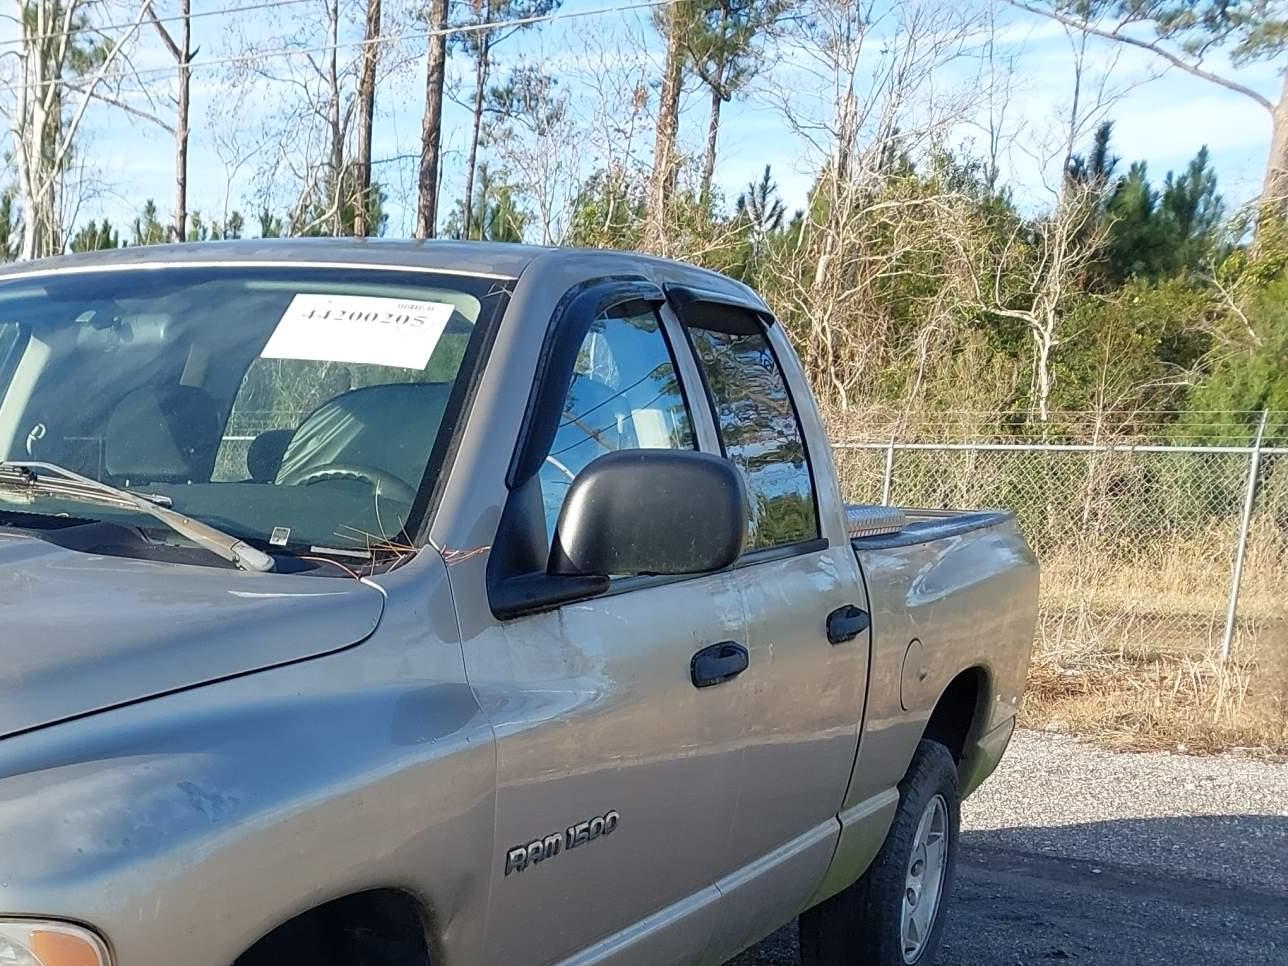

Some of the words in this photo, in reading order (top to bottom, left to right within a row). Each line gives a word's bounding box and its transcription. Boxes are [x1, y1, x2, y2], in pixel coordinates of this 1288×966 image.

[301, 308, 430, 328] 44200205
[504, 832, 562, 876] RAM
[565, 809, 620, 850] 1500
